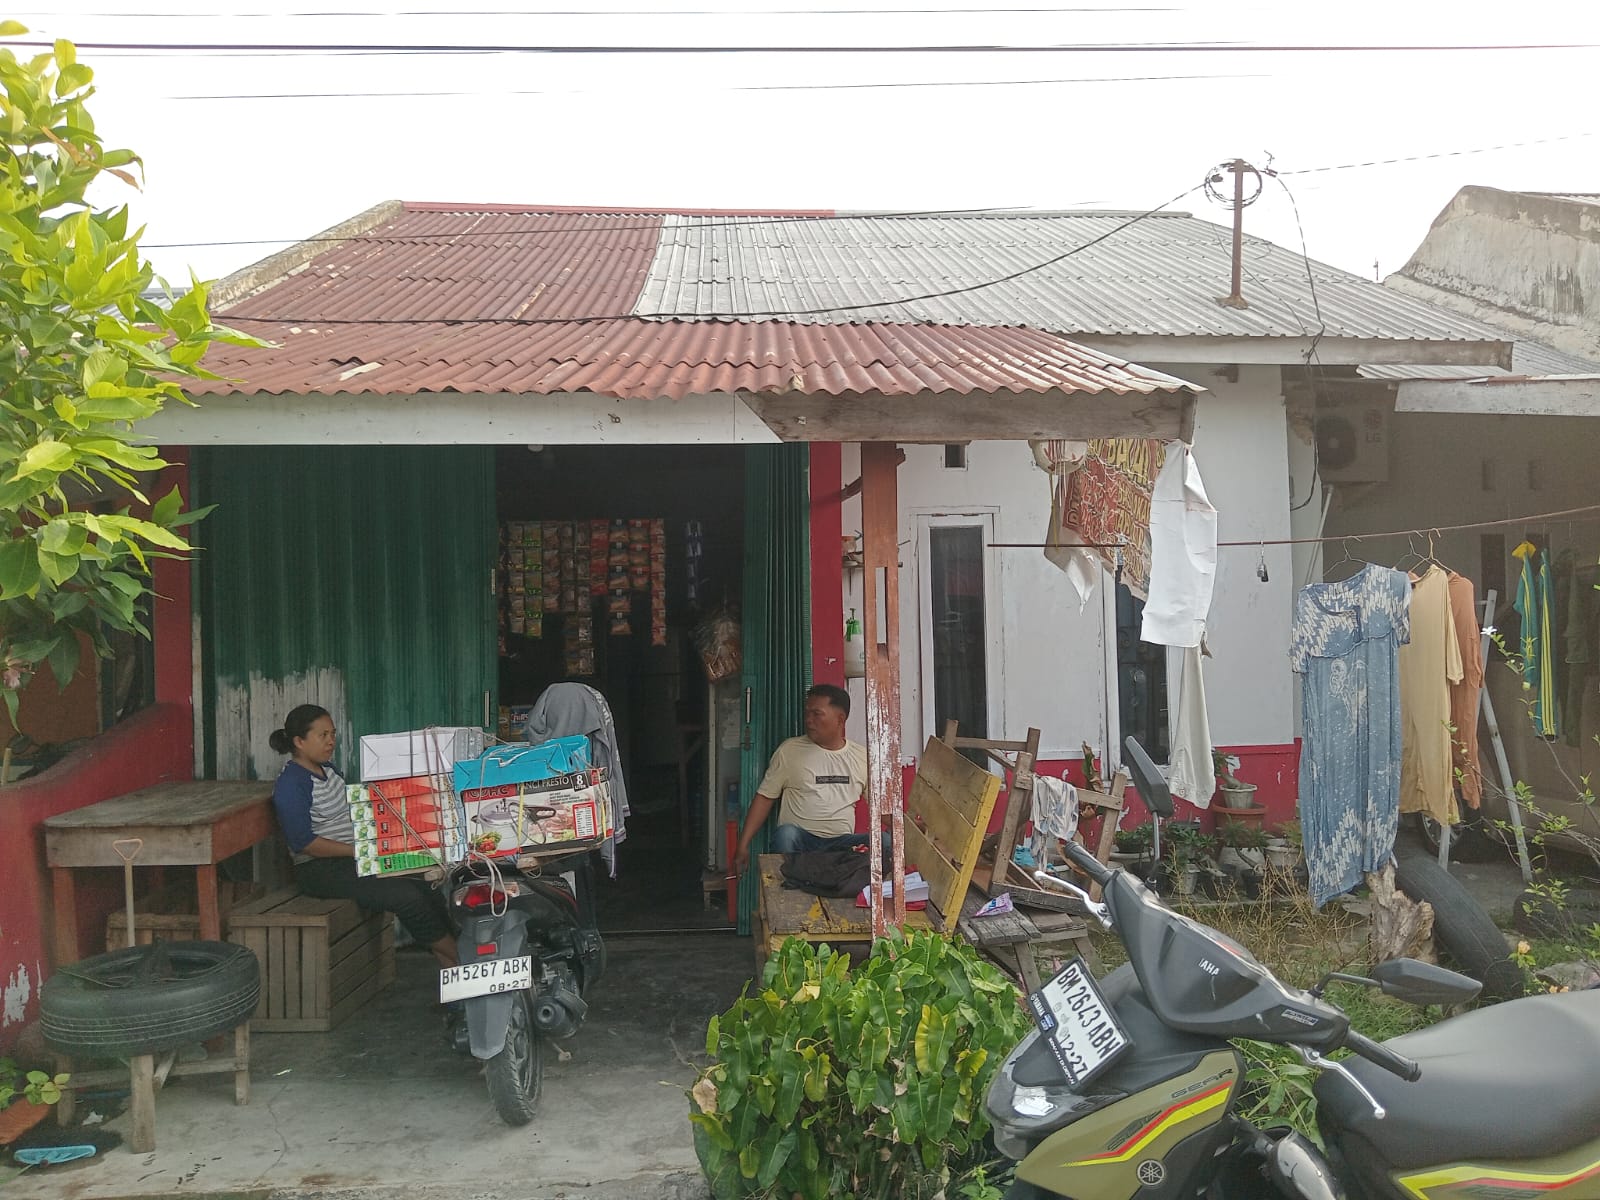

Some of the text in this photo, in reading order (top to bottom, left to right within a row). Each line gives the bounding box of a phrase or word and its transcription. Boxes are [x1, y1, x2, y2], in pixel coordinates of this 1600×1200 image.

[576, 774, 584, 785] 8
[442, 958, 529, 985] BM 5267 ABK
[1057, 967, 1121, 1060] BM 2643 ABN
